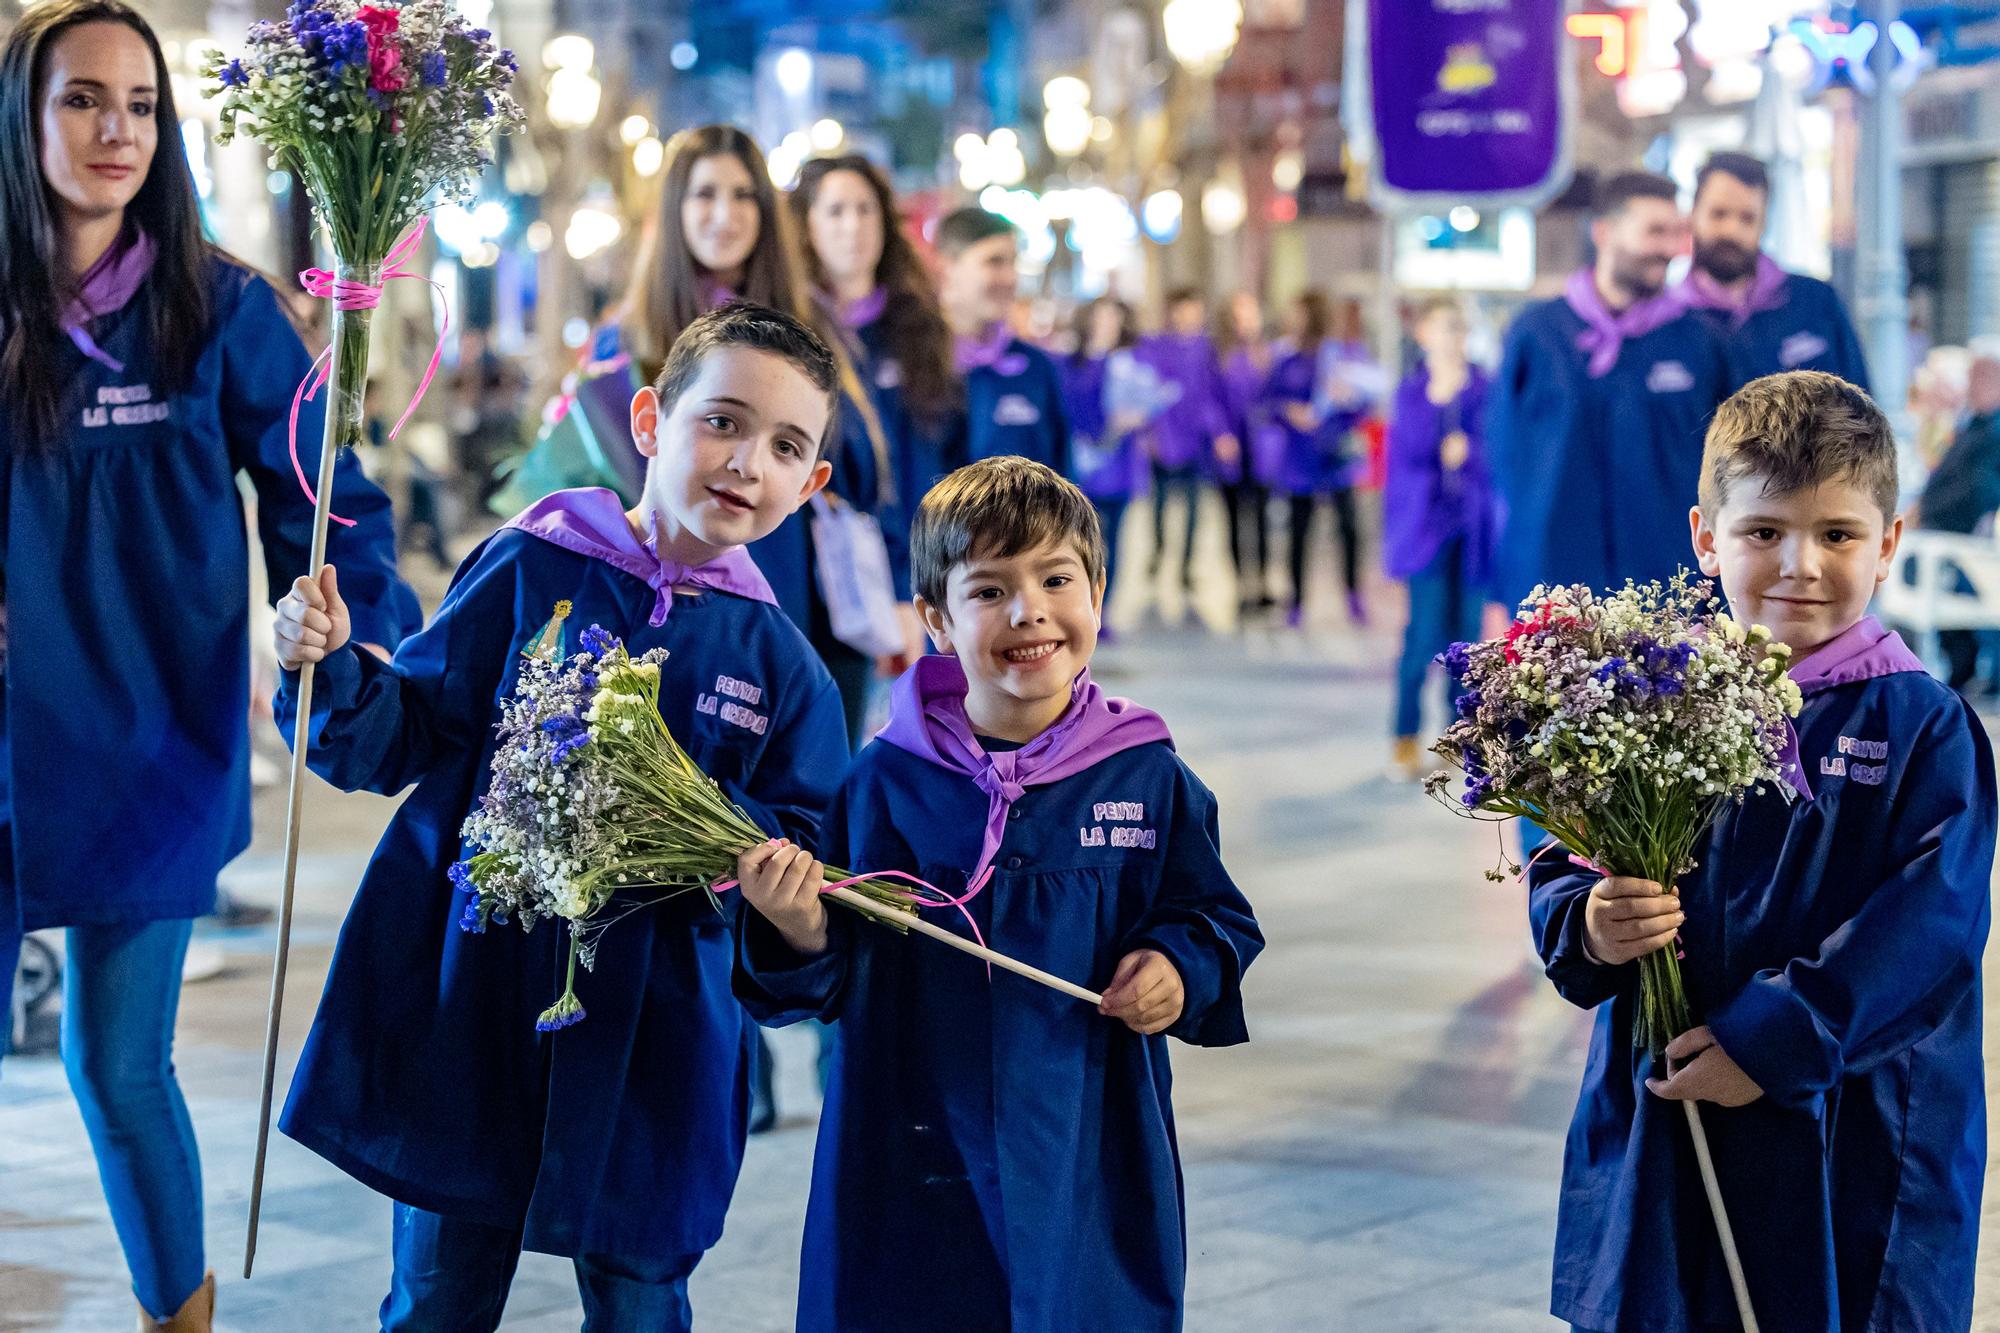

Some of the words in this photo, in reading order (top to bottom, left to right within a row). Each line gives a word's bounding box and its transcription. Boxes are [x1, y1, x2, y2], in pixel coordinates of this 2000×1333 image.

[715, 674, 762, 705] PENYA
[696, 692, 718, 715] LA
[1820, 756, 1847, 777] LA
[1093, 801, 1144, 822] PENYA
[1080, 826, 1106, 847] LA
